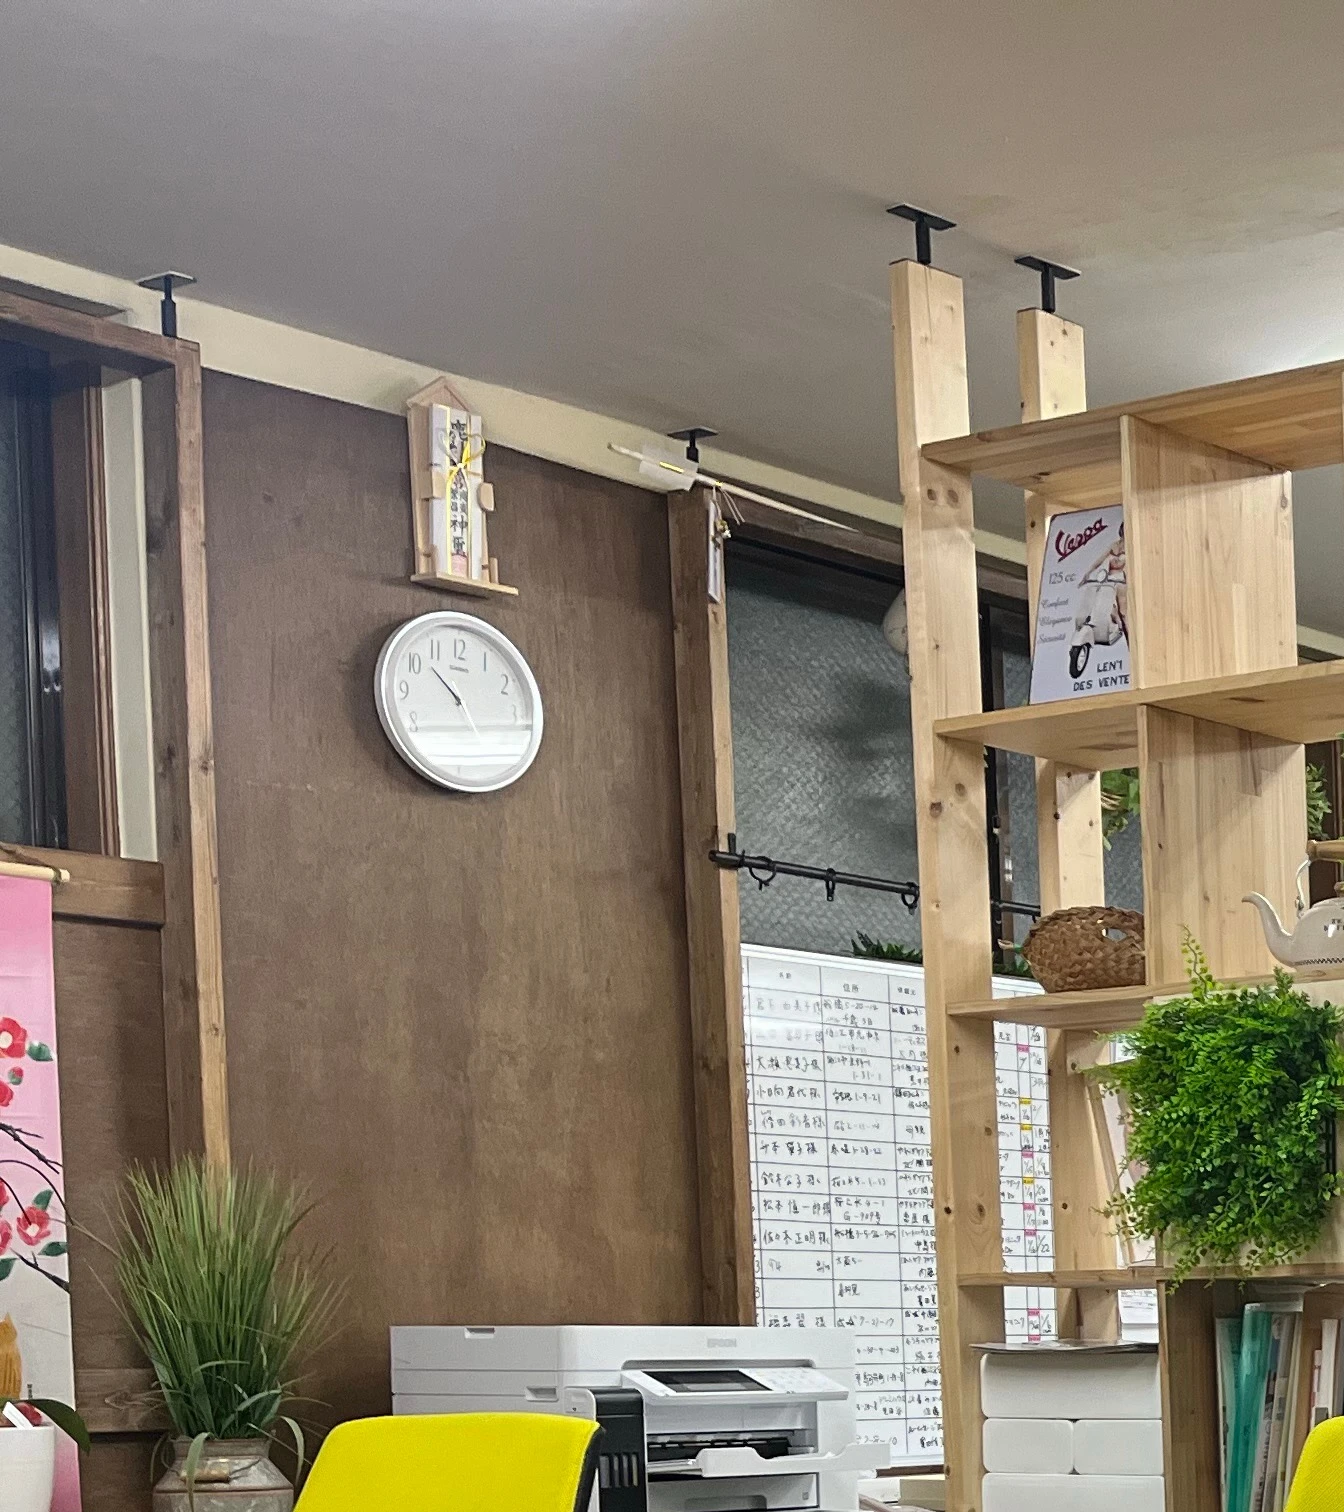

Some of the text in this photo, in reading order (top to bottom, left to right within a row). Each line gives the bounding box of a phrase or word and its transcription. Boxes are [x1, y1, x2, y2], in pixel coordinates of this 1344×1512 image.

[1055, 518, 1108, 562] Vespa
[1049, 572, 1063, 585] 125
[430, 639, 440, 661] 11
[454, 638, 466, 661] 12
[408, 651, 422, 674] 10
[399, 680, 409, 700] 9
[501, 673, 509, 695] 2
[1073, 680, 1093, 692] DES
[409, 711, 418, 733] 8
